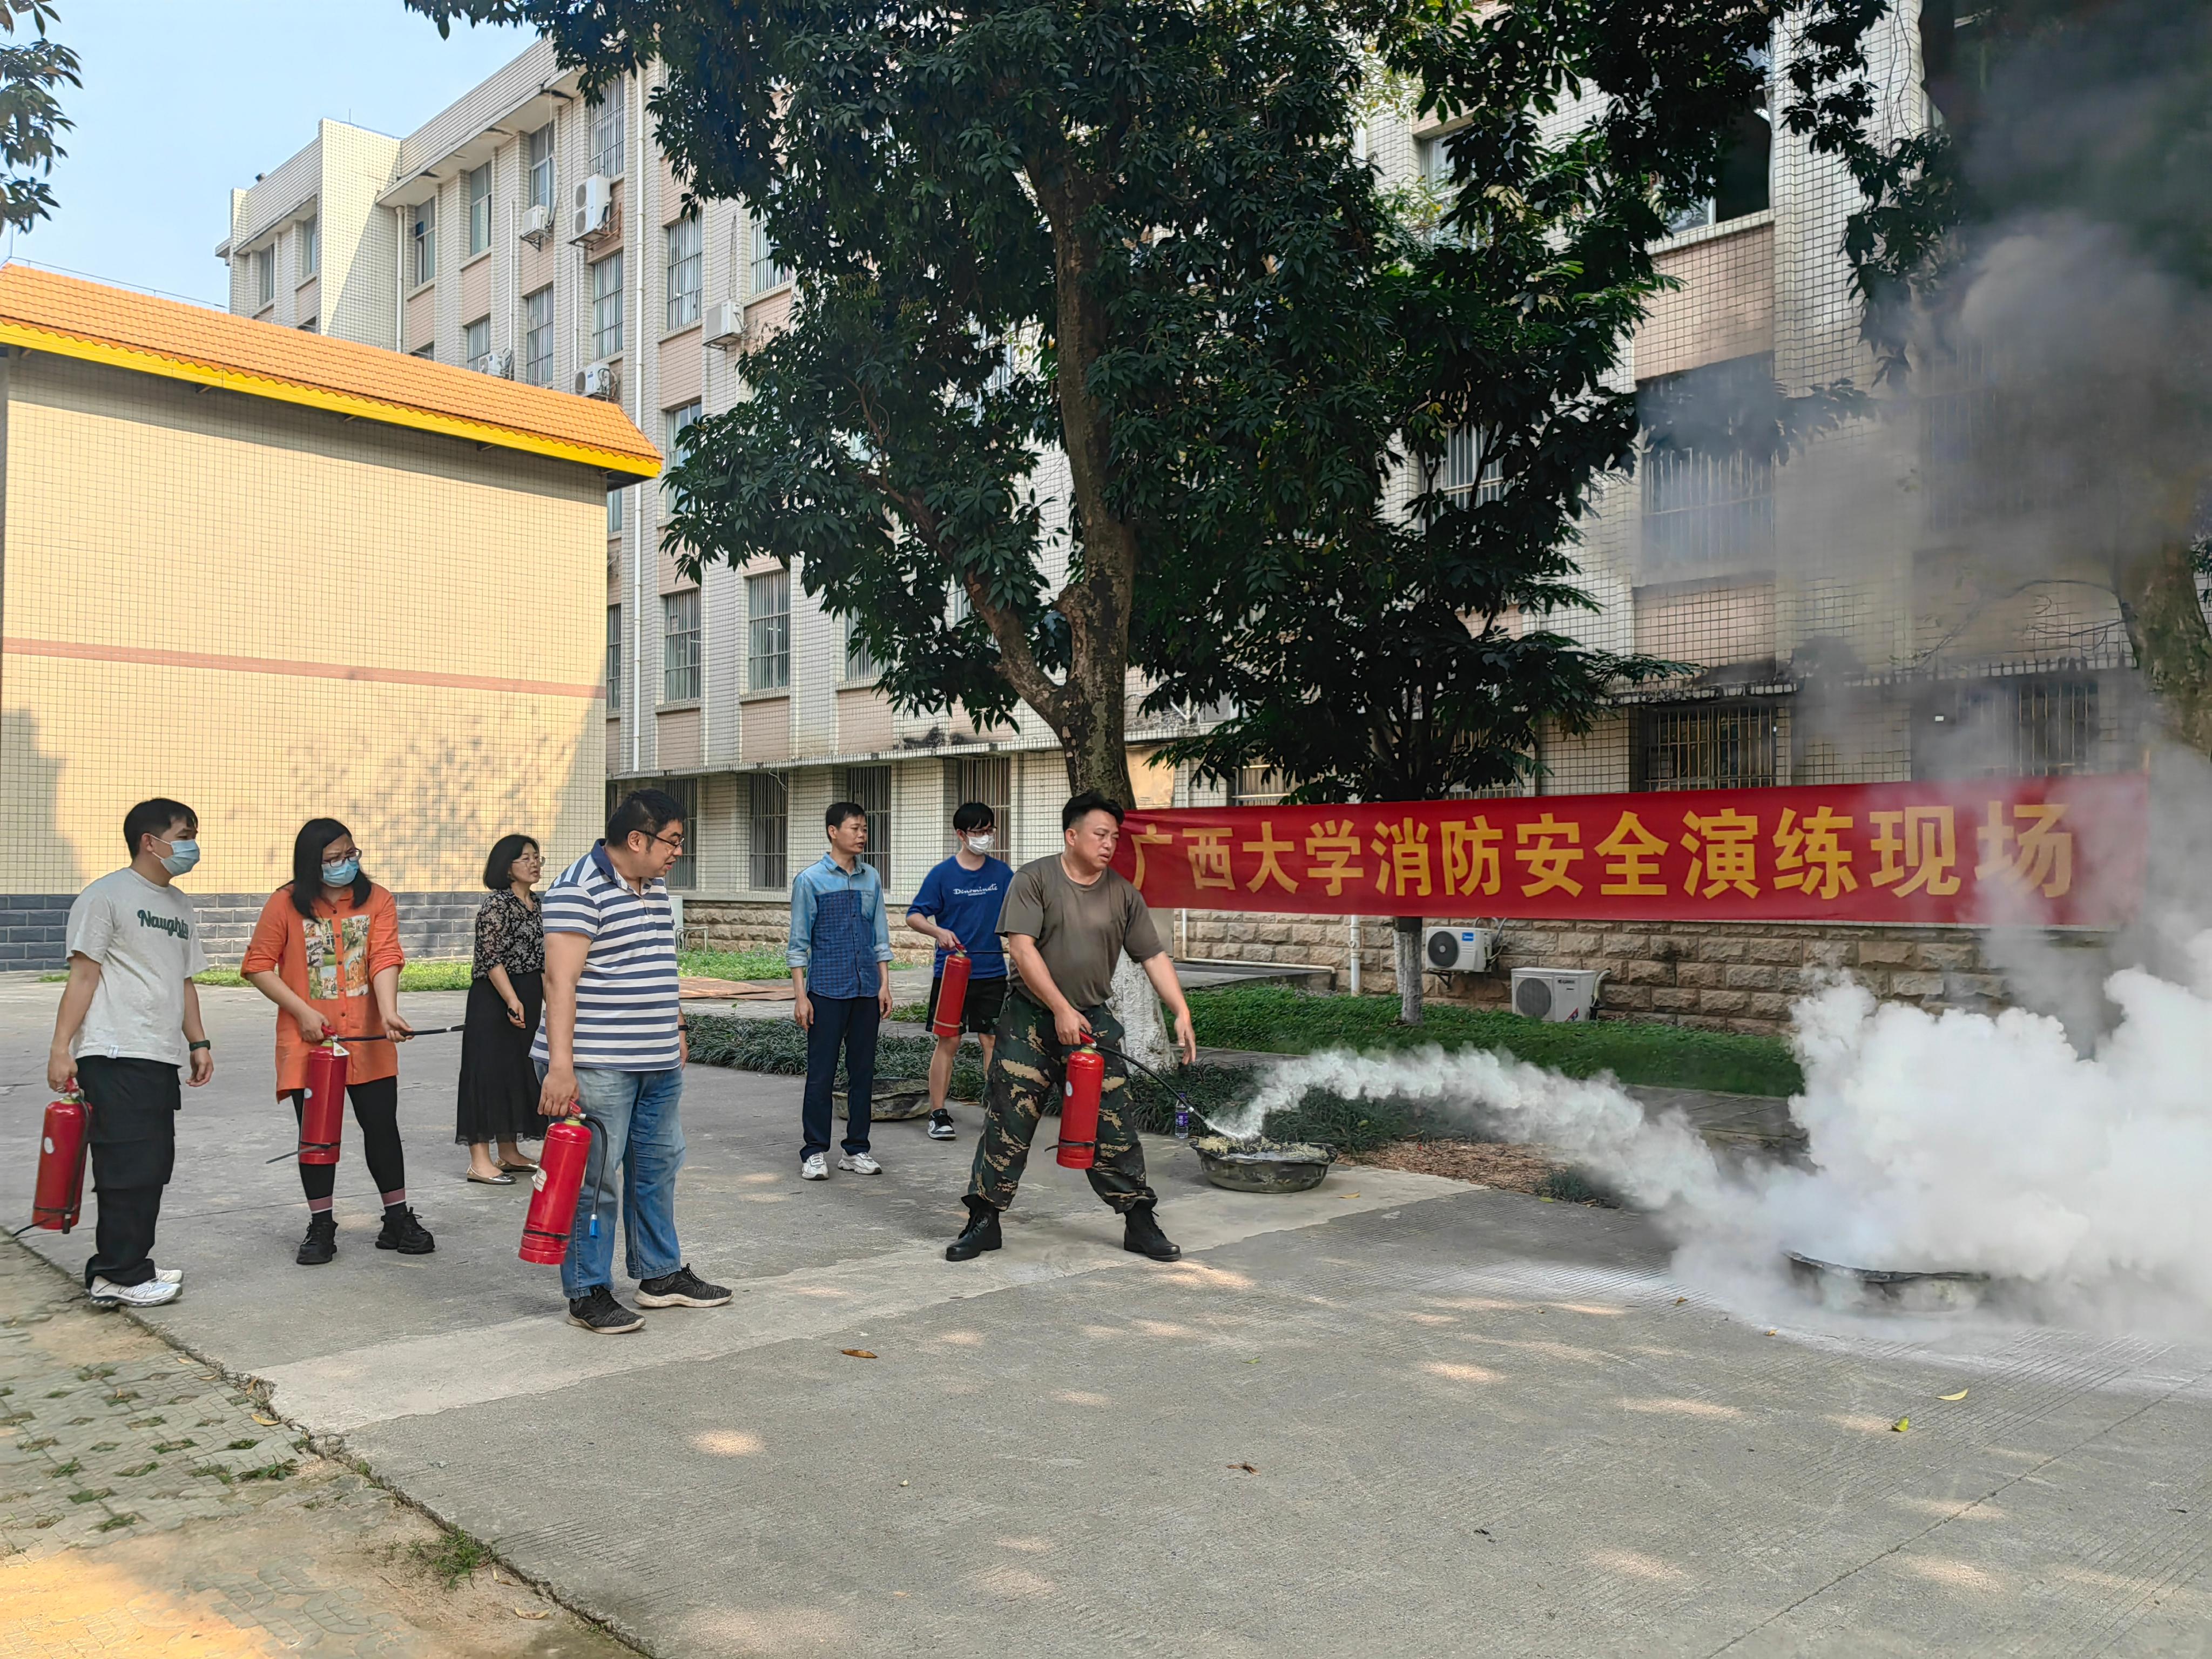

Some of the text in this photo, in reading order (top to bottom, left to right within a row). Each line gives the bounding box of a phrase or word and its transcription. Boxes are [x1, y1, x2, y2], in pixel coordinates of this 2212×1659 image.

[1131, 800, 2073, 900] 广西大学消防安全演练现场
